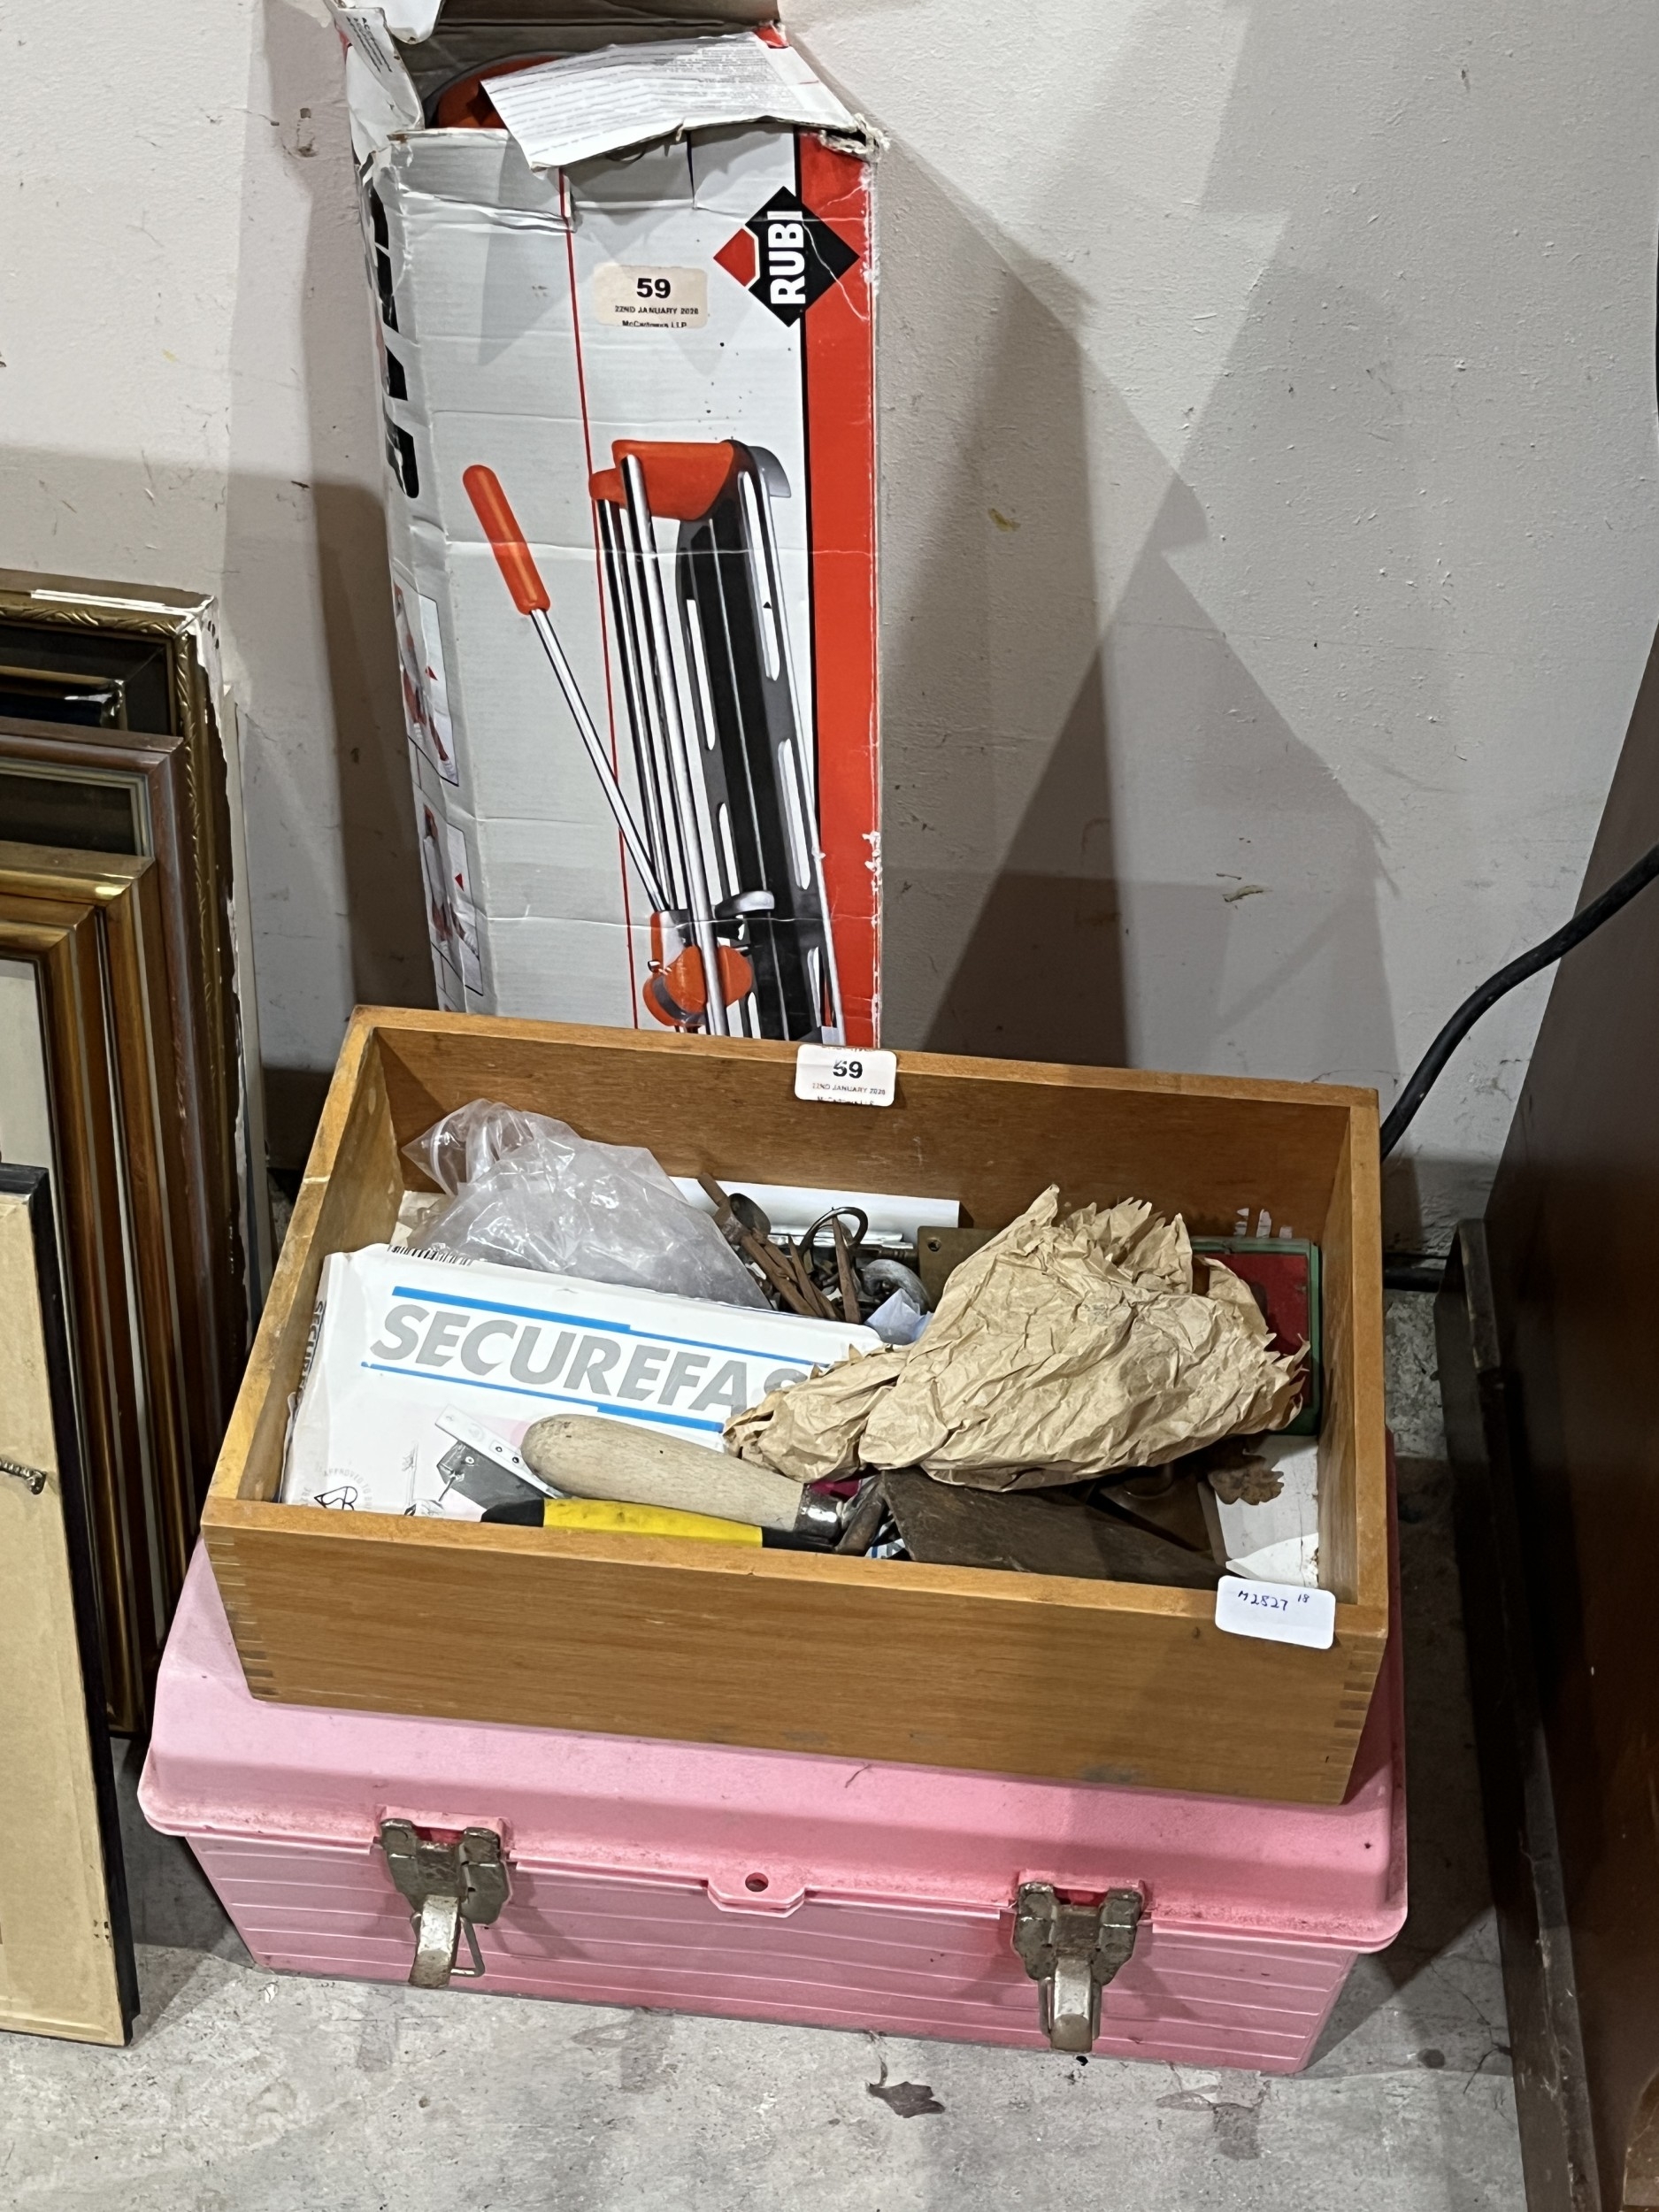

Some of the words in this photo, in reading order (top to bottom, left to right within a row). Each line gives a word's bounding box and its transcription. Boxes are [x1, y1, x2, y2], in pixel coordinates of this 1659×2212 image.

[767, 211, 806, 304] RUBI
[636, 277, 672, 299] 59
[615, 304, 636, 313] 22ND
[638, 306, 678, 315] JANUARY
[833, 1059, 864, 1079] 59
[833, 1084, 868, 1094] JANUARY
